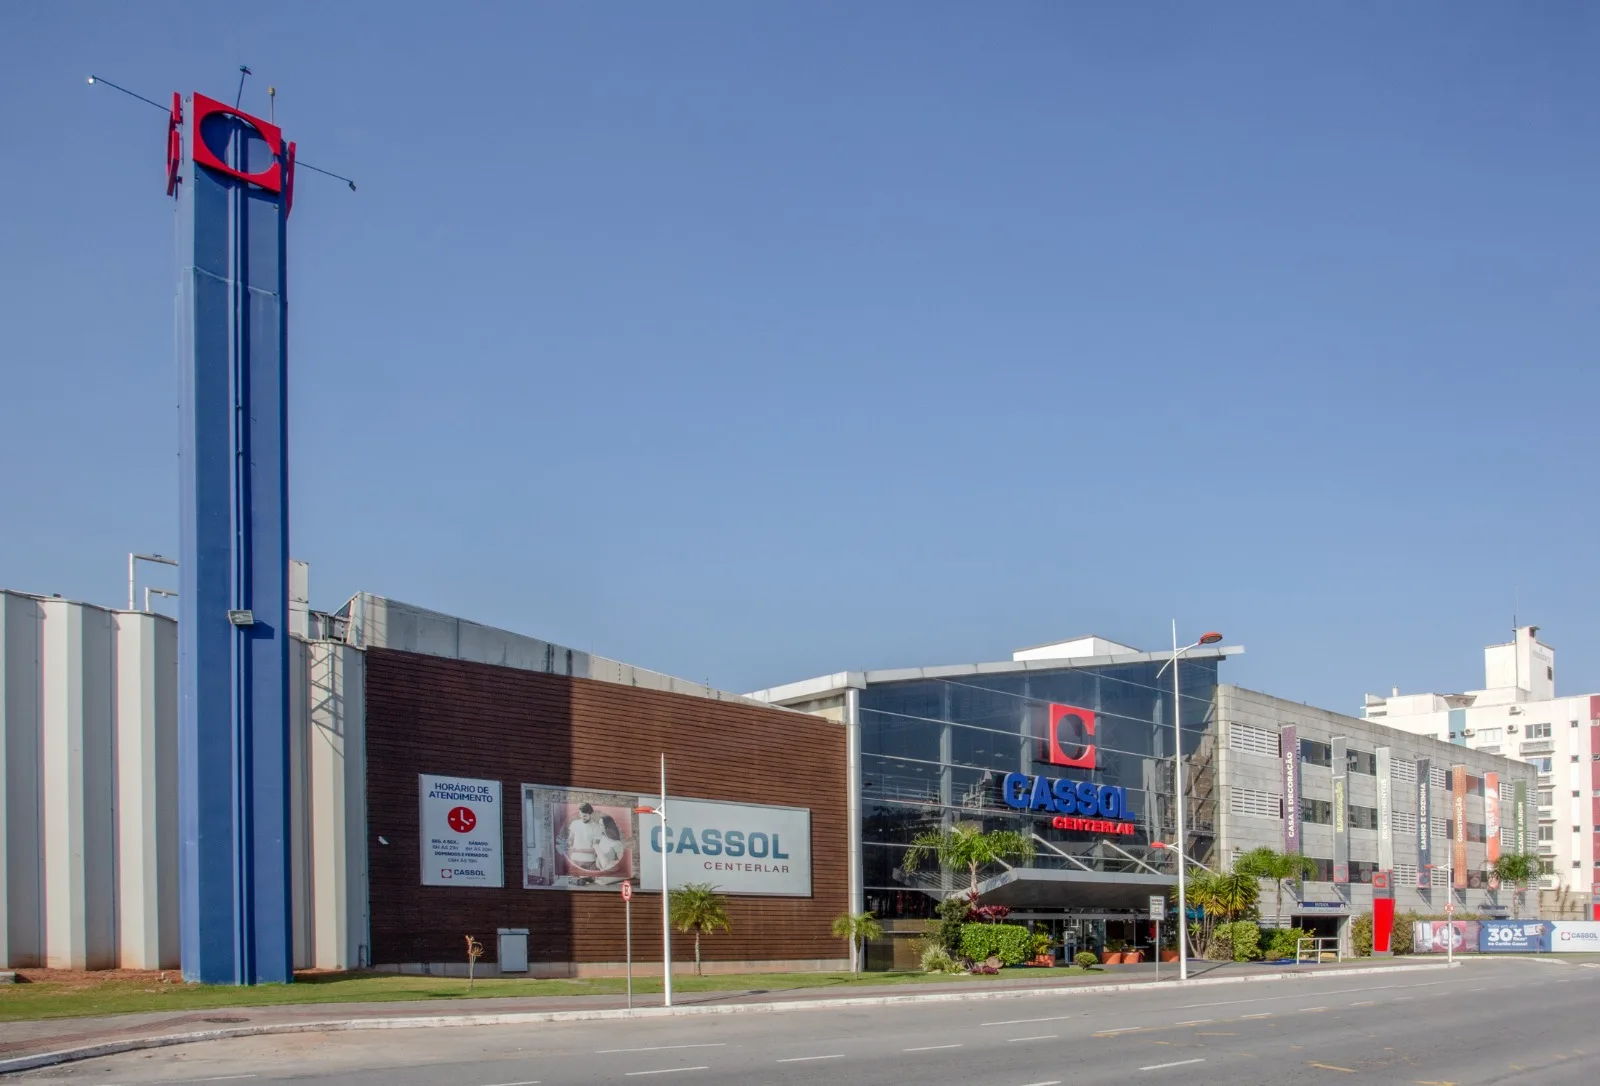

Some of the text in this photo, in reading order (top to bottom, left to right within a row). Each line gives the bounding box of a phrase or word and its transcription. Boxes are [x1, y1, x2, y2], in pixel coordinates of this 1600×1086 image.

[1286, 752, 1294, 804] DECORAÇÃO
[434, 782, 489, 794] HORÁRIO DE
[429, 790, 493, 803] ATENDIMENTO
[1003, 773, 1135, 820] CASSOL
[1288, 805, 1294, 813] E
[1052, 816, 1135, 835] CENTERLAR
[651, 825, 789, 859] CASSOL
[703, 861, 789, 873] CENTERLAR
[1487, 928, 1523, 942] 30x
